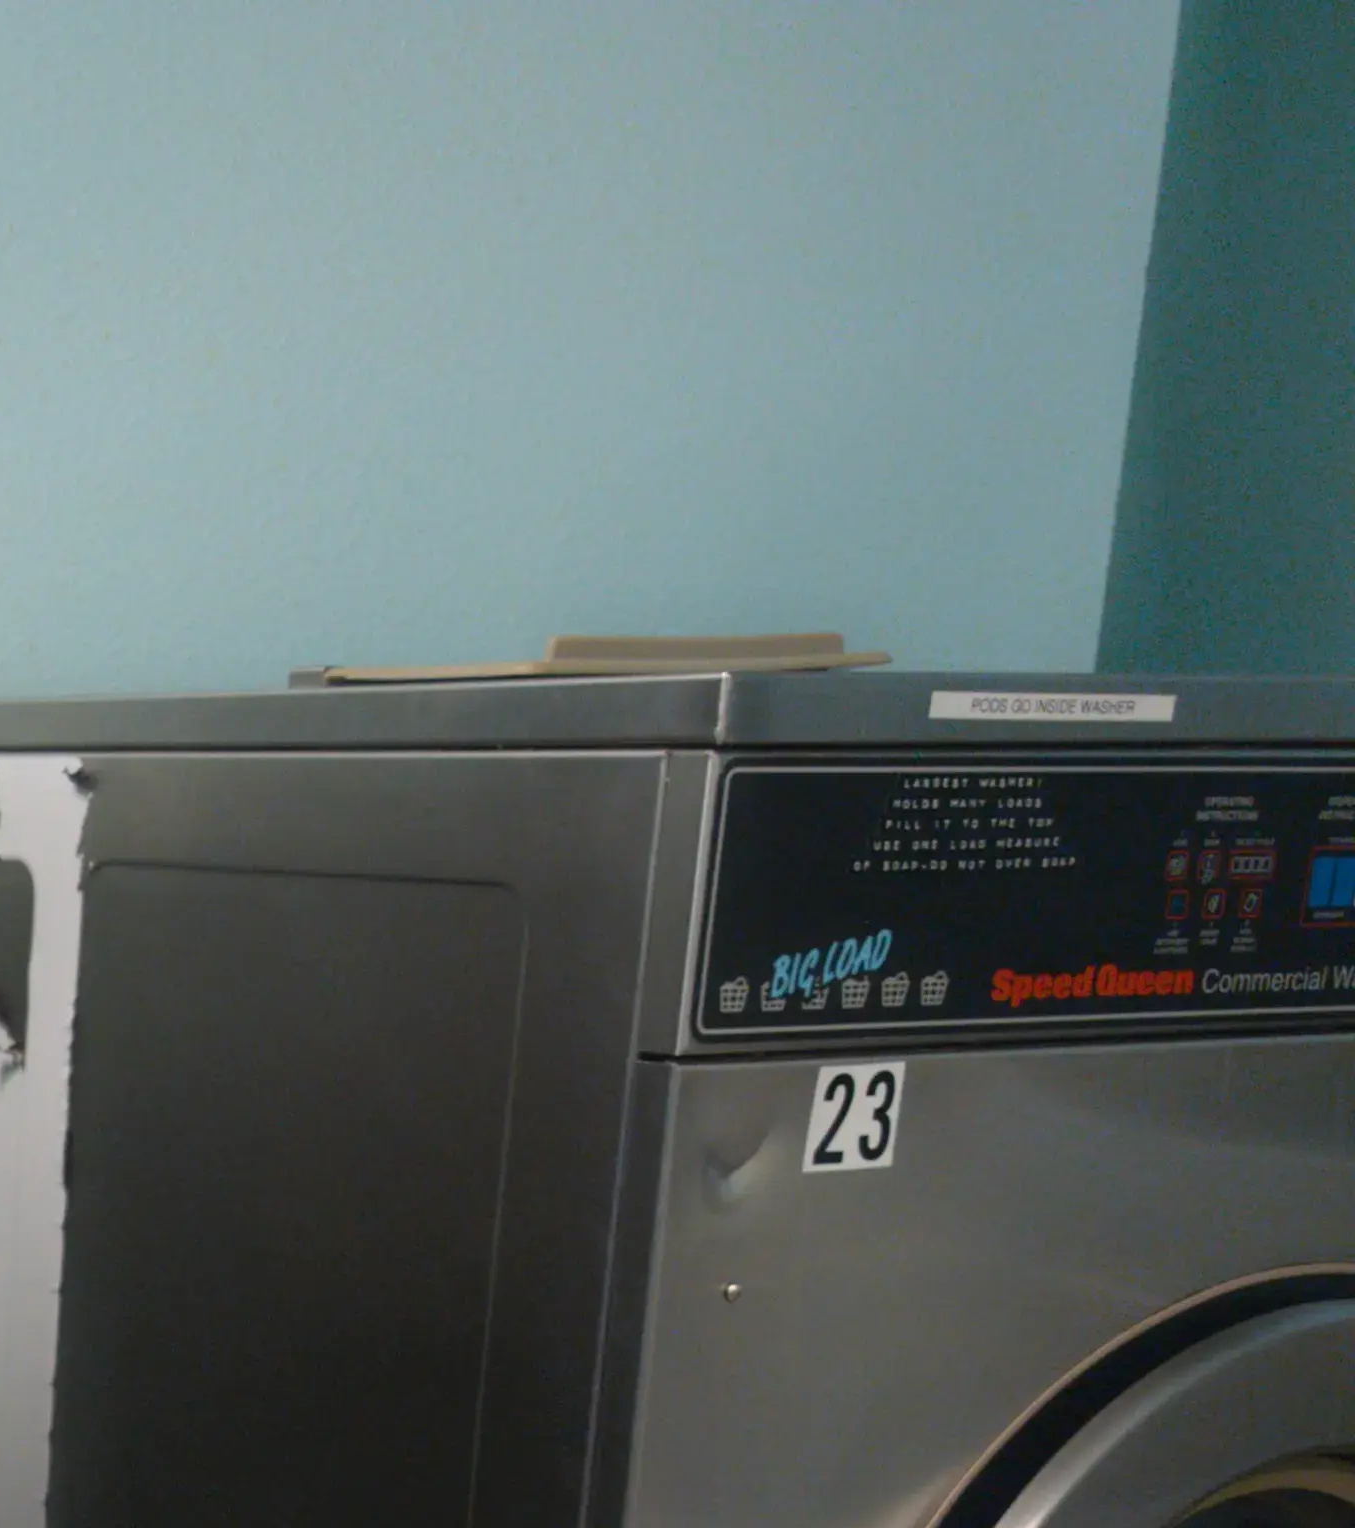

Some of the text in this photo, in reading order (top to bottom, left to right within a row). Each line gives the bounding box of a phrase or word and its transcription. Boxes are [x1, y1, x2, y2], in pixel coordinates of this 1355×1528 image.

[1034, 699, 1077, 715] INSIDE
[1081, 700, 1136, 715] WASHER
[904, 778, 970, 789] LARGEST
[770, 928, 892, 998] BIG LOAD
[990, 965, 1095, 1008] Speed
[1095, 963, 1195, 997] Queen
[1201, 963, 1327, 995] Commercial
[812, 1070, 896, 1165] 23
